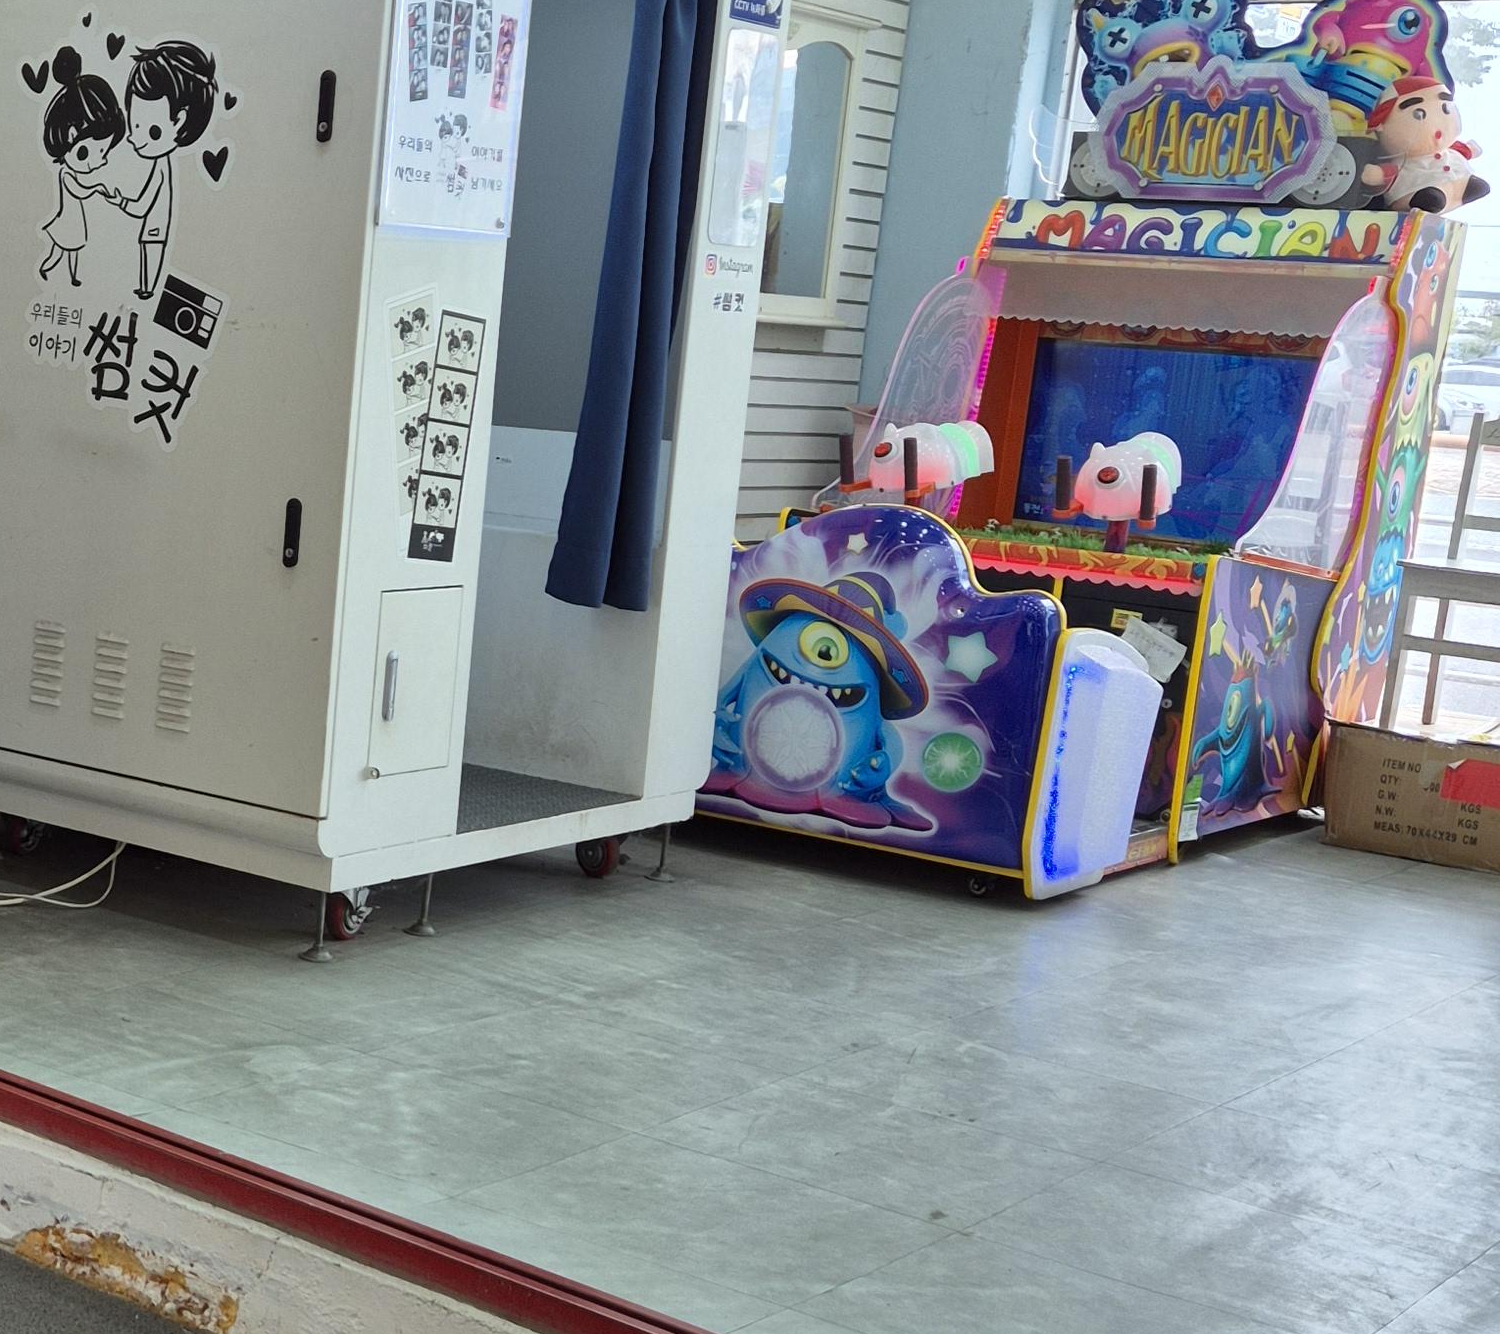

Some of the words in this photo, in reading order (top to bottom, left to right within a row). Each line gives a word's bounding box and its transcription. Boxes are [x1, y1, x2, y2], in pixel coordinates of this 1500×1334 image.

[398, 134, 433, 153] 우리들의
[1121, 95, 1301, 181] MAGICIAN
[394, 165, 432, 183] 사진으로
[1036, 210, 1382, 261] MAGICIAN
[29, 302, 84, 329] 우리들의
[28, 331, 77, 363] 이야기
[1381, 757, 1406, 771] ITEM
[1422, 781, 1441, 794] 00
[1460, 802, 1482, 815] KGS
[1457, 817, 1480, 831] KGS
[1461, 834, 1478, 846] CM
